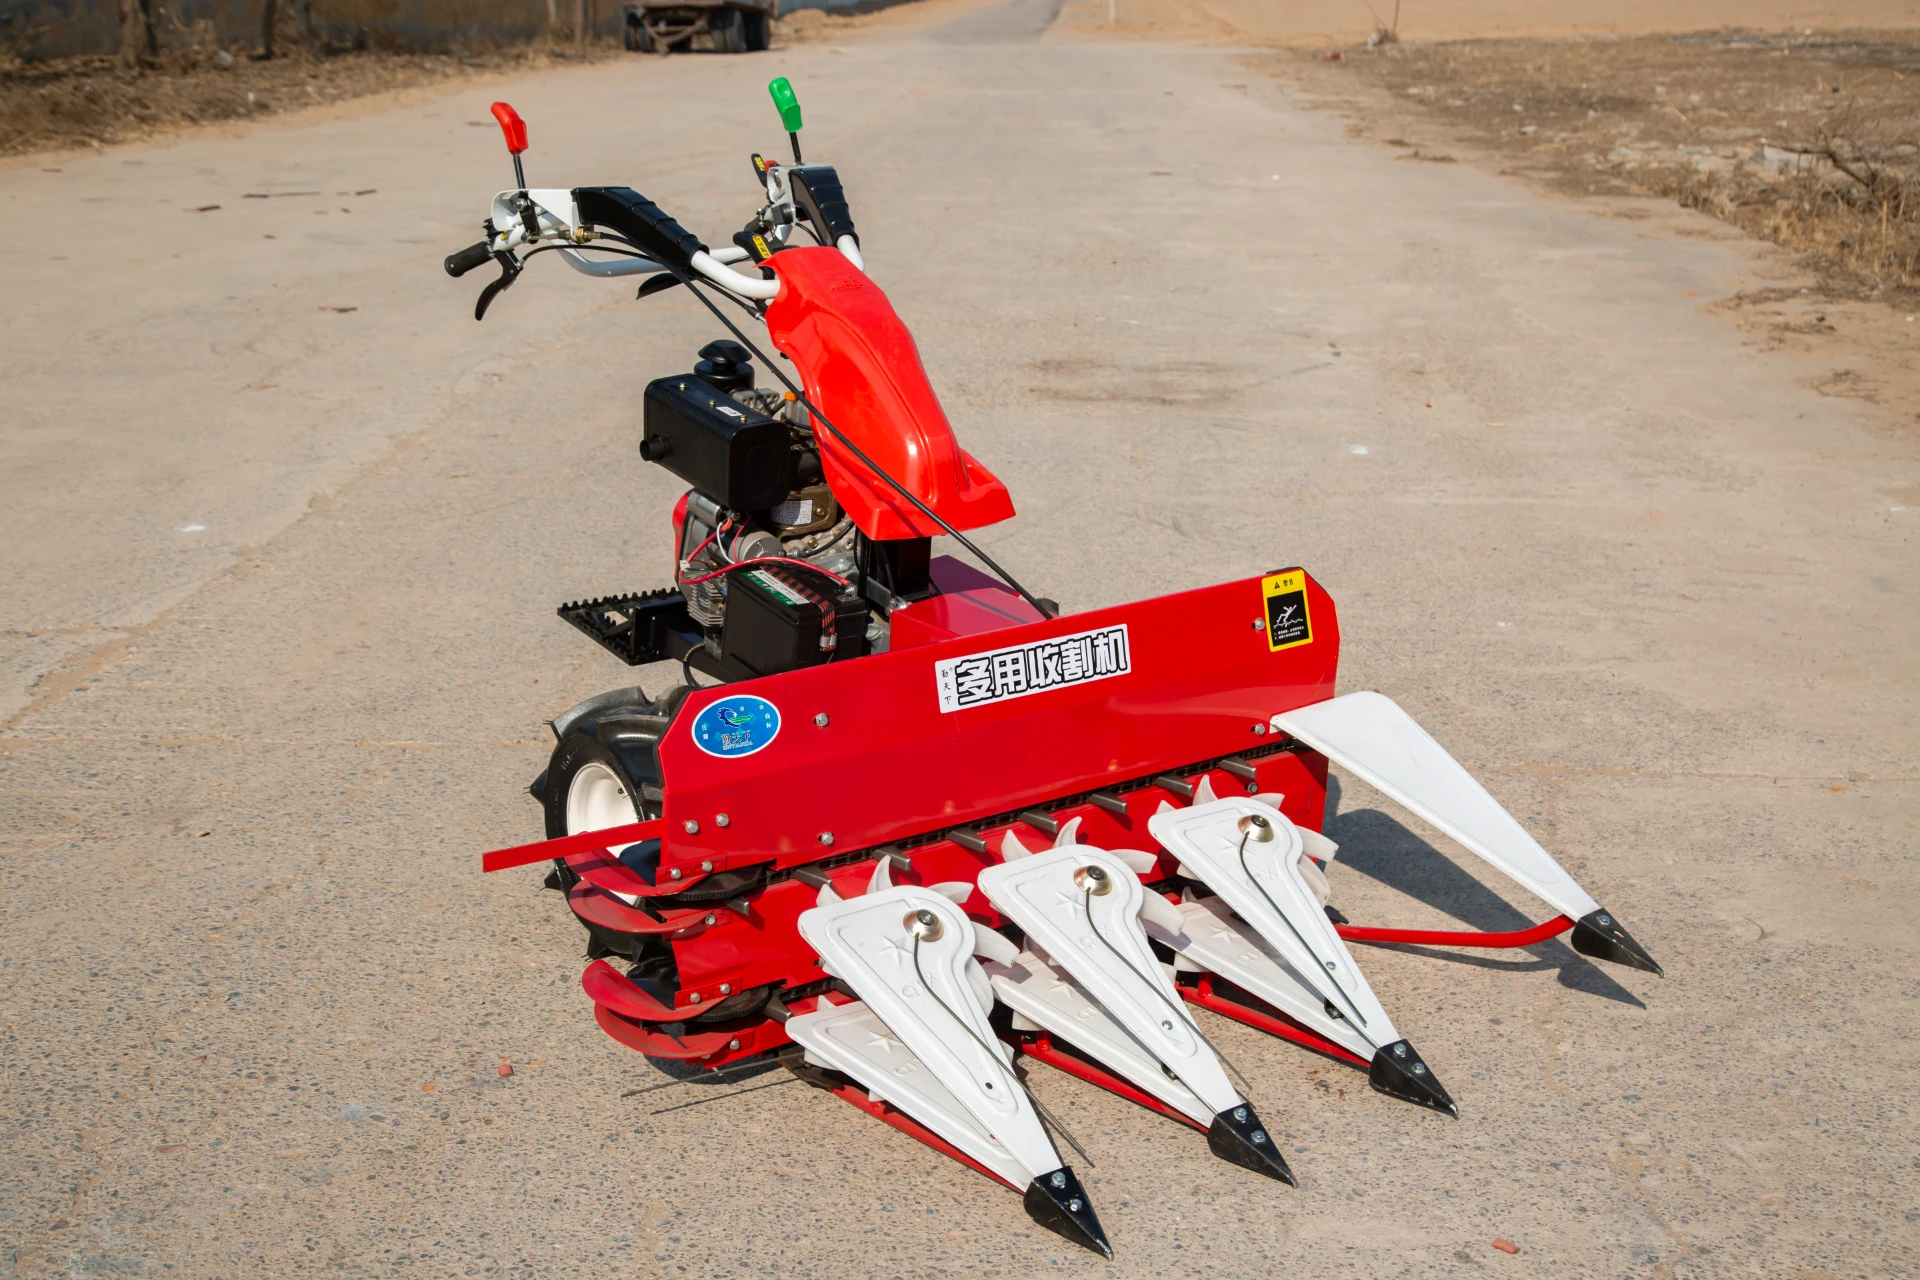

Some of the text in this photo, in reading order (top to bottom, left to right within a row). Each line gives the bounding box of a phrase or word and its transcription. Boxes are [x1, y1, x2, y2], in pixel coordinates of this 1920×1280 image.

[941, 669, 952, 705] 勤天下
[954, 628, 1128, 706] 多用收割机
